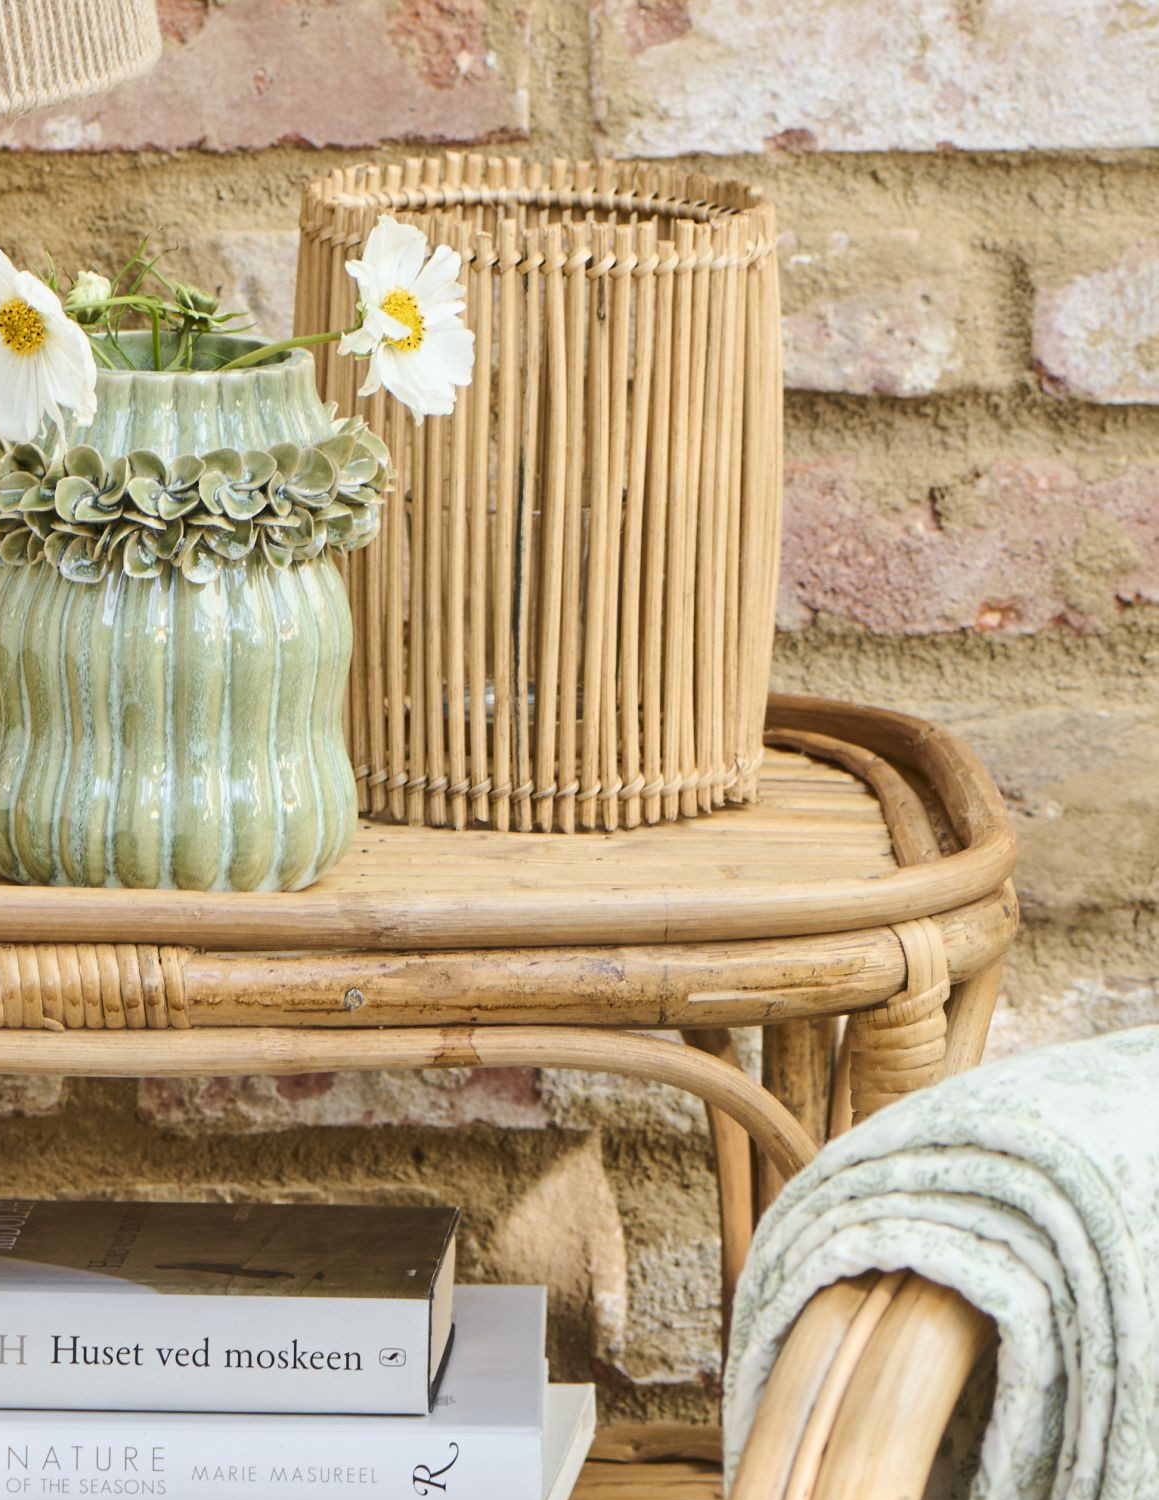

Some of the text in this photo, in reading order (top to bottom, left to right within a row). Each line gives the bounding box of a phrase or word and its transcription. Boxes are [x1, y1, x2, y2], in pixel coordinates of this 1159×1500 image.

[50, 1335, 144, 1366] Huset
[156, 1337, 211, 1368] ved
[224, 1339, 364, 1372] moskeen
[7, 1444, 166, 1472] NATURE
[5, 1477, 32, 1494] OF
[40, 1478, 71, 1494] THE
[79, 1478, 167, 1496] SEASONS
[190, 1465, 378, 1485] MARIE MASUREEL
